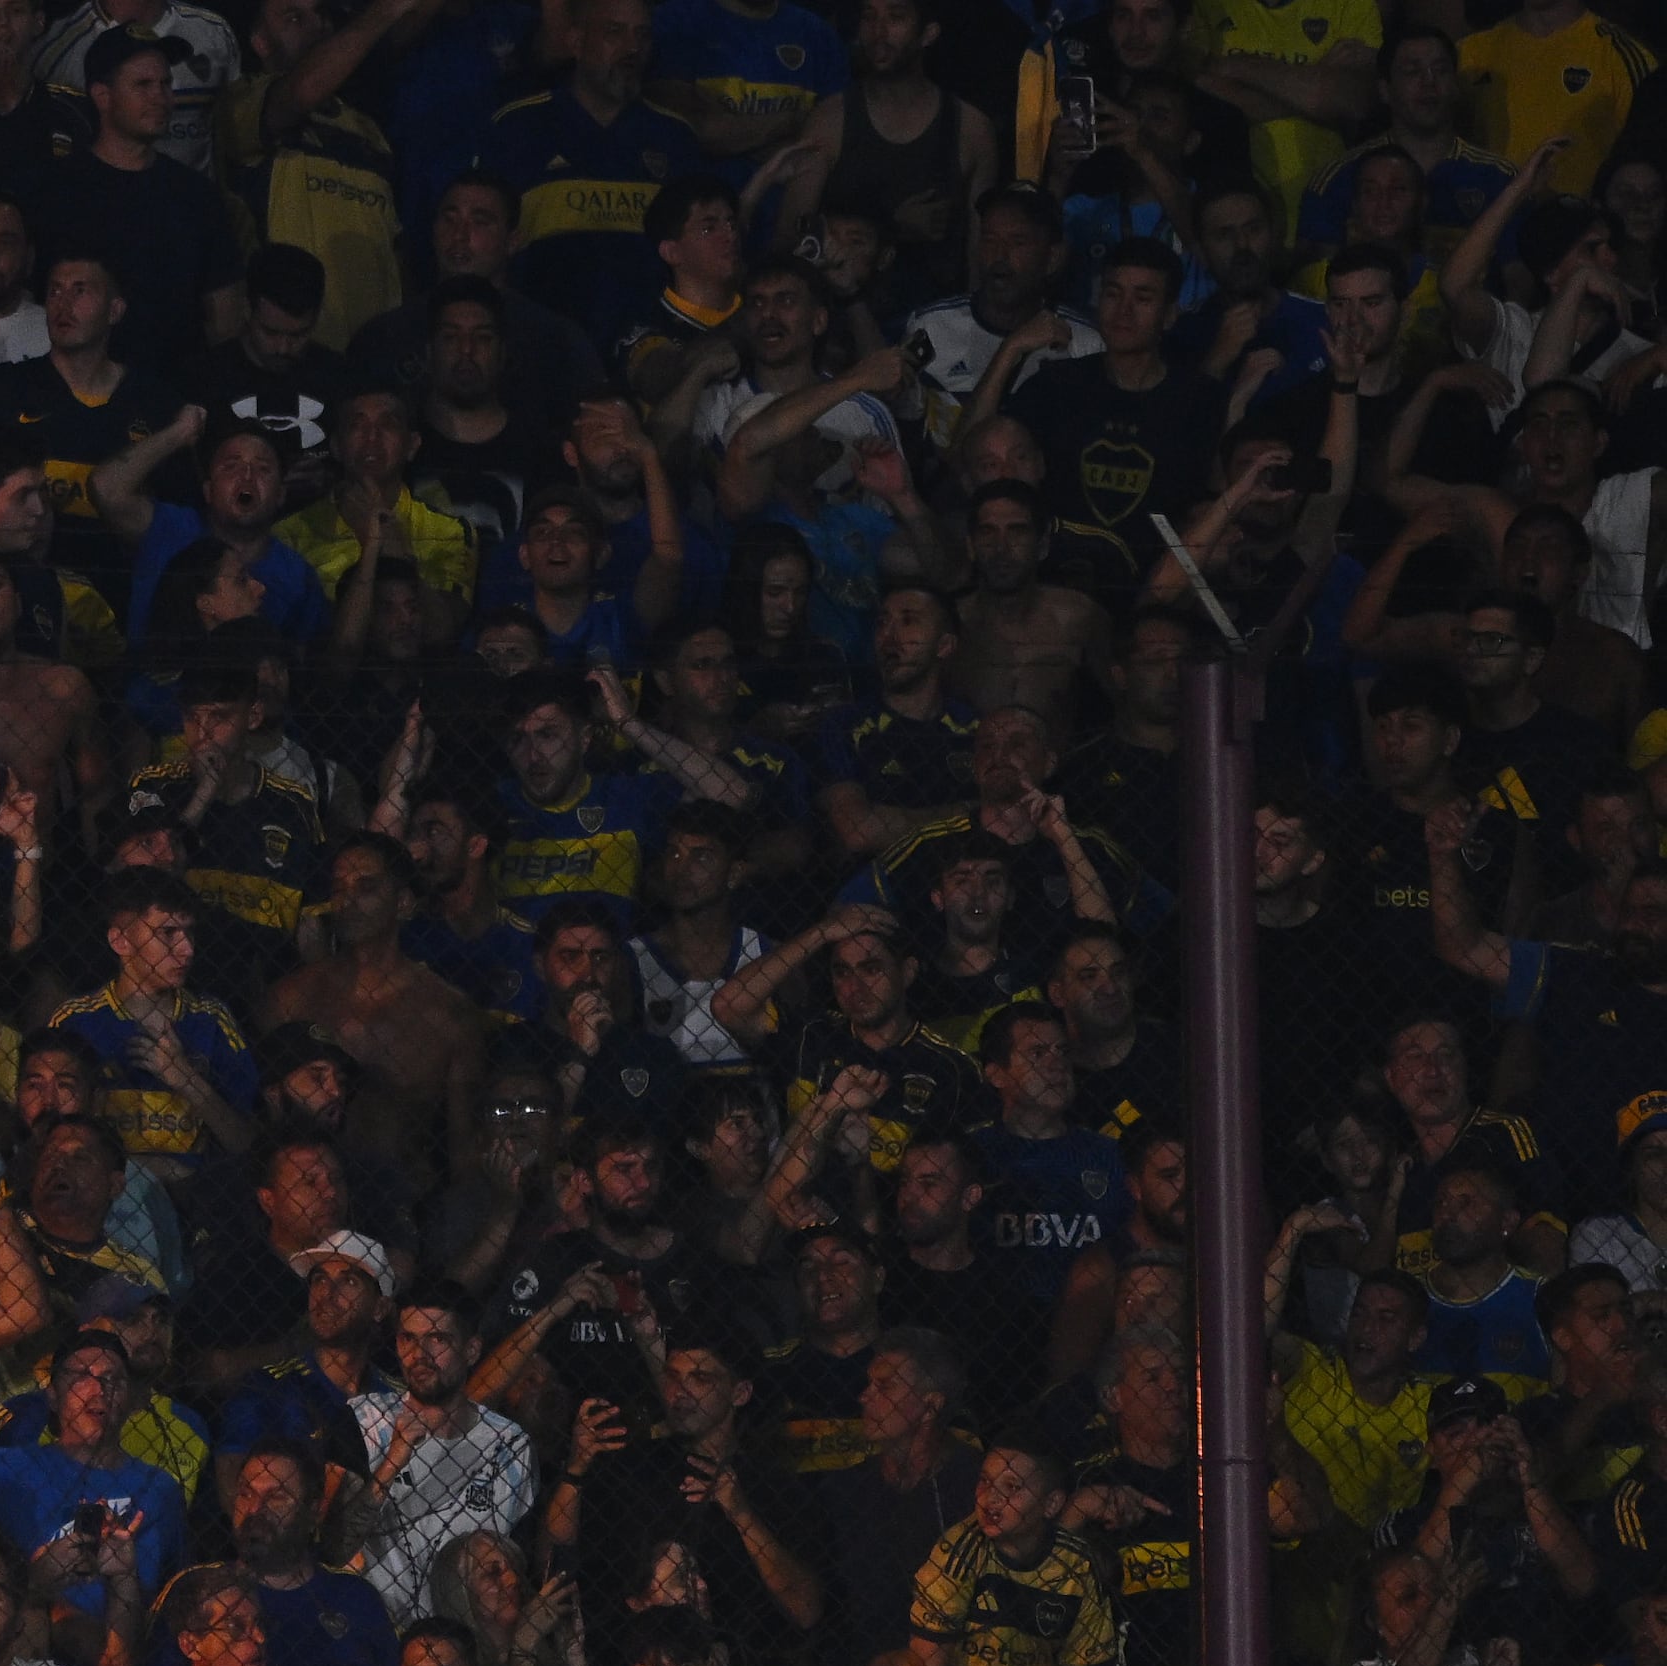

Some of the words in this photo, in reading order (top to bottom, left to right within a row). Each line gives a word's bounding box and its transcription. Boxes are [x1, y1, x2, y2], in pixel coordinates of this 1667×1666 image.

[304, 174, 390, 210] betsson
[566, 189, 648, 211] QATAR
[1088, 467, 1142, 489] CABJ
[995, 1213, 1102, 1249] BBVA
